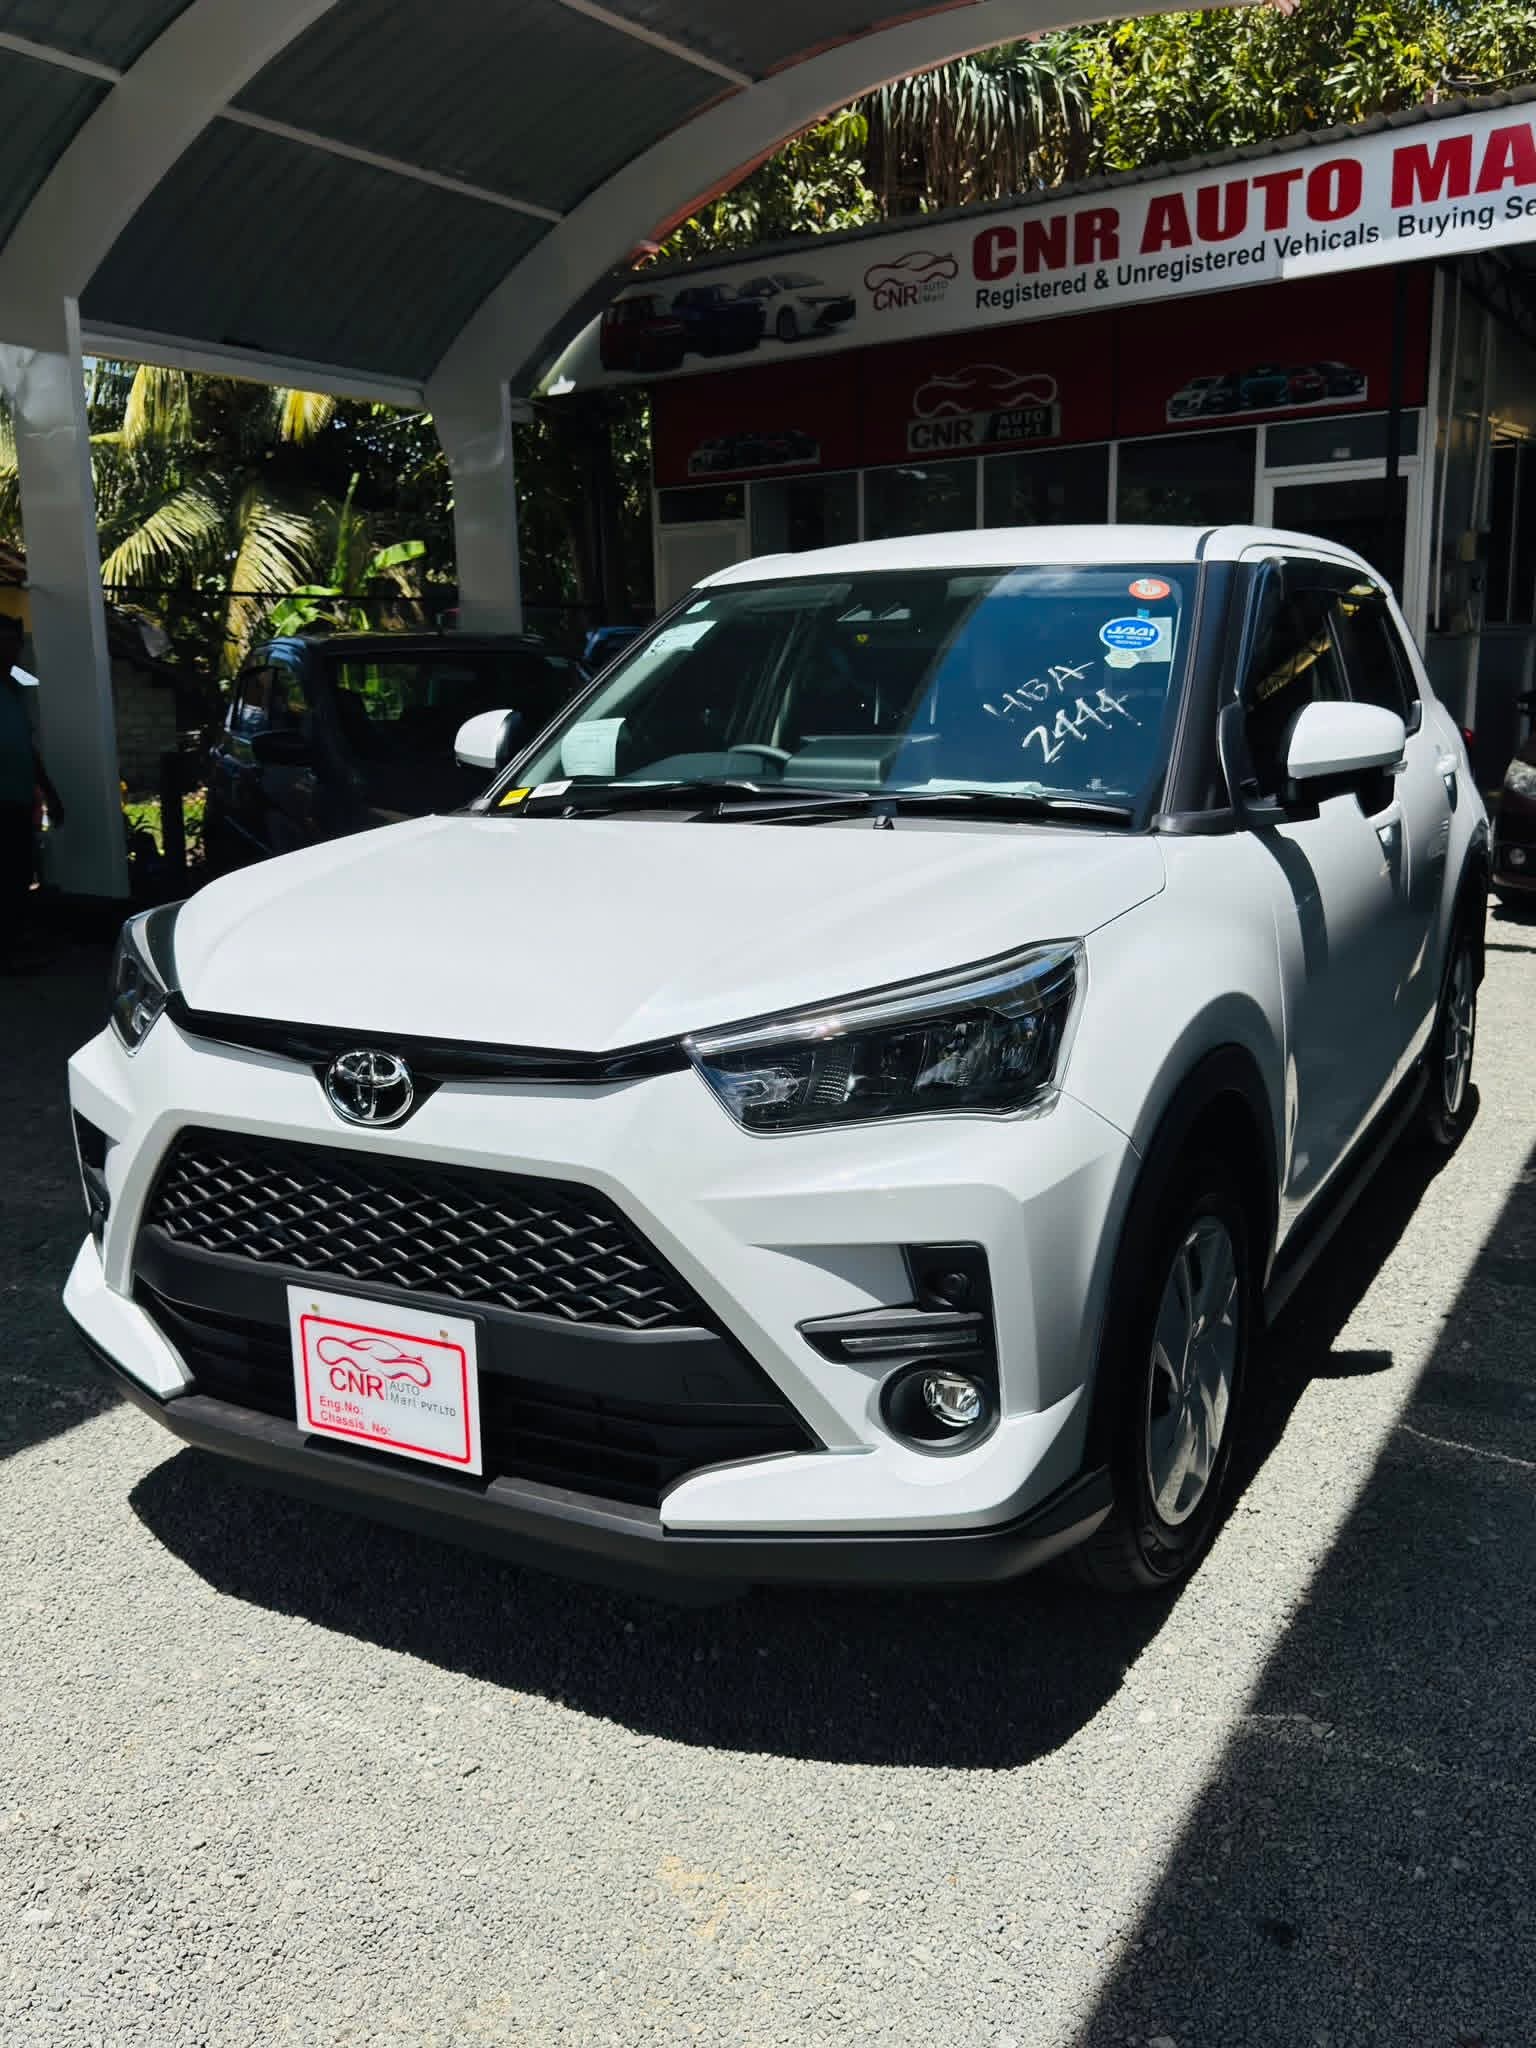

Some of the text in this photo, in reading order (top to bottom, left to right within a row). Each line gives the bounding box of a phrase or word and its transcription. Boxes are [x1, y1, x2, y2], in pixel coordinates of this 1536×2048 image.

[972, 123, 1536, 281] CNR AUTO MA
[976, 272, 1087, 310] Registered
[1094, 268, 1109, 290] &
[1117, 240, 1266, 286] Unregistered
[1274, 222, 1379, 259] Vehicals
[1398, 206, 1494, 238] Buying
[873, 284, 919, 311] CNR
[1000, 409, 1044, 425] AUTO
[911, 419, 973, 448] CNR
[330, 1367, 384, 1401] CNR
[389, 1381, 420, 1396] AUTO
